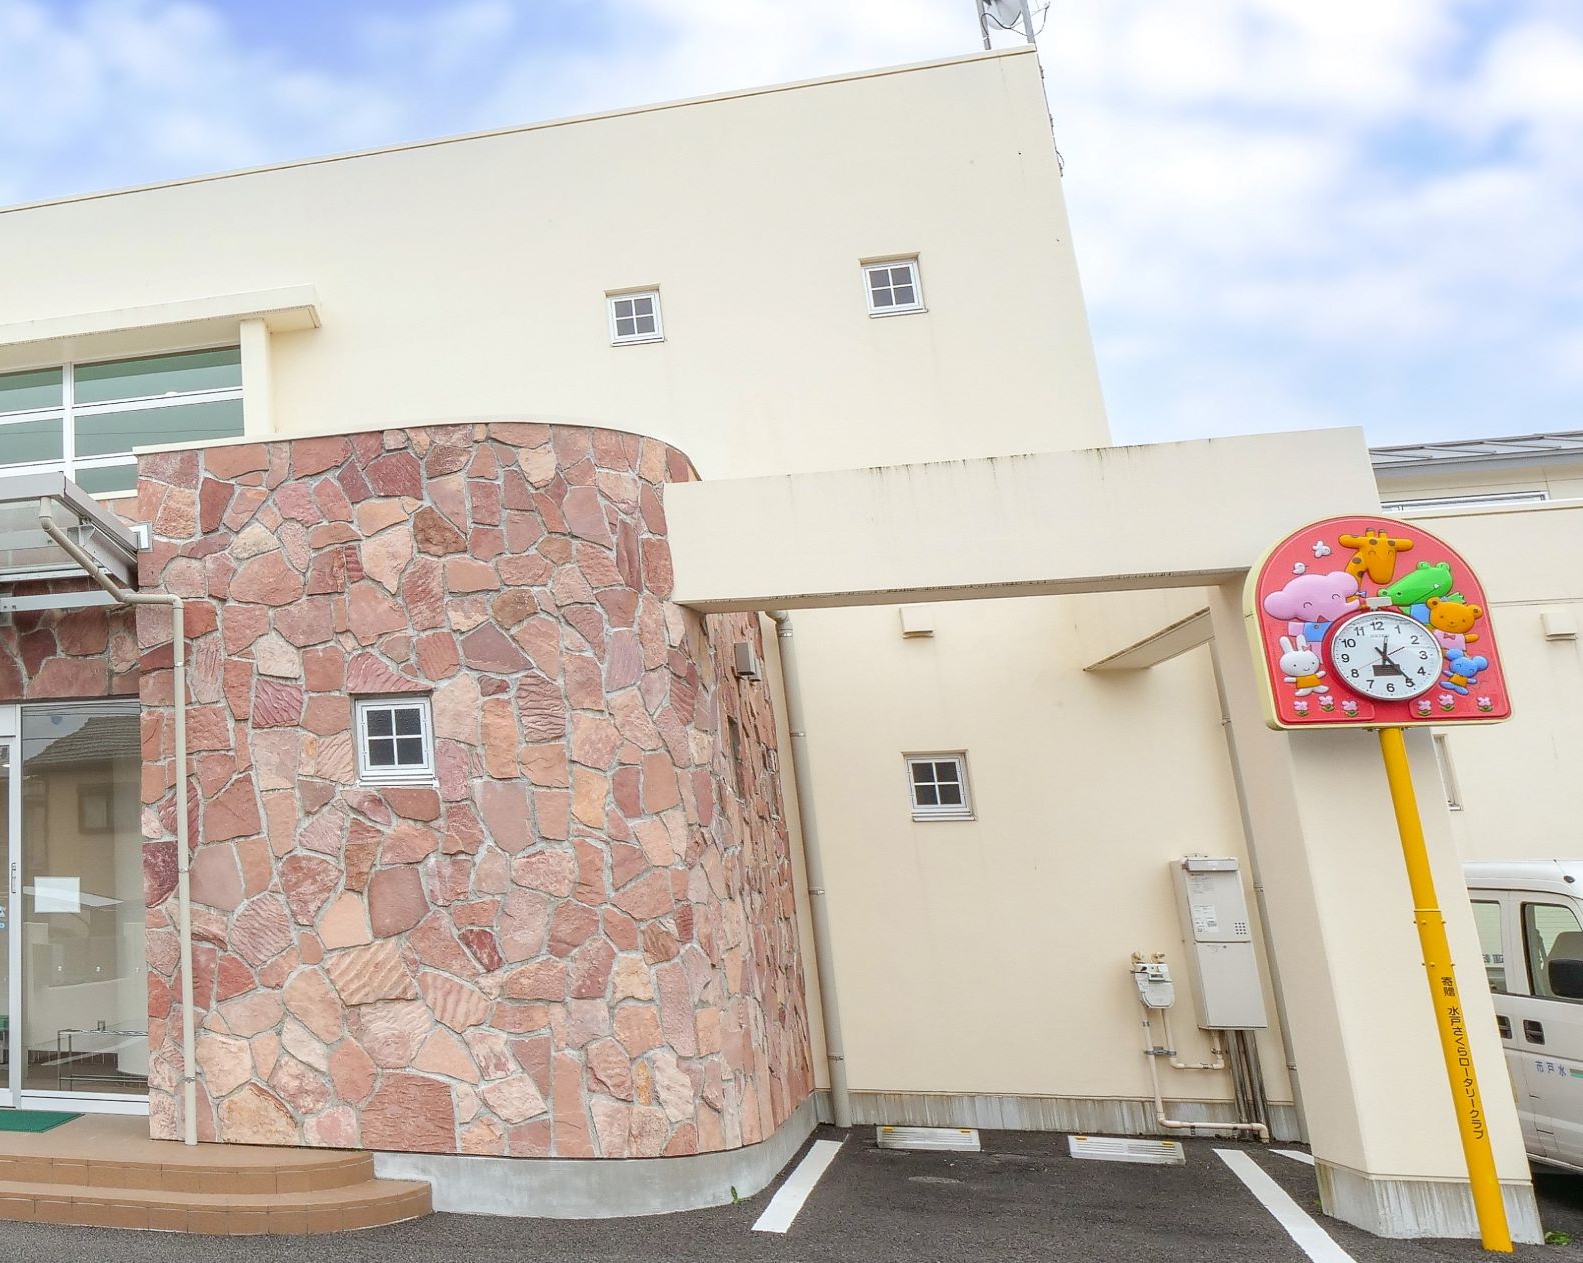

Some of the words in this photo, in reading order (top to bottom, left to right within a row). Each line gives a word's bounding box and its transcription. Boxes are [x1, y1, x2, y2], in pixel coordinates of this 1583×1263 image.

[1370, 621, 1384, 631] 12
[1395, 624, 1401, 634] 1
[1354, 627, 1365, 636] 11
[1342, 638, 1356, 648] 10
[1410, 635, 1420, 645] 2
[1341, 653, 1350, 663] 9
[1419, 650, 1428, 660] 3
[1351, 668, 1360, 678] 8
[1417, 666, 1426, 676] 4
[1366, 679, 1374, 689] 7
[1386, 683, 1395, 692] 6
[1405, 678, 1415, 688] 5
[1441, 976, 1456, 997] 寄贈
[1447, 1006, 1484, 1139] 水戸さくらロータリークラブ
